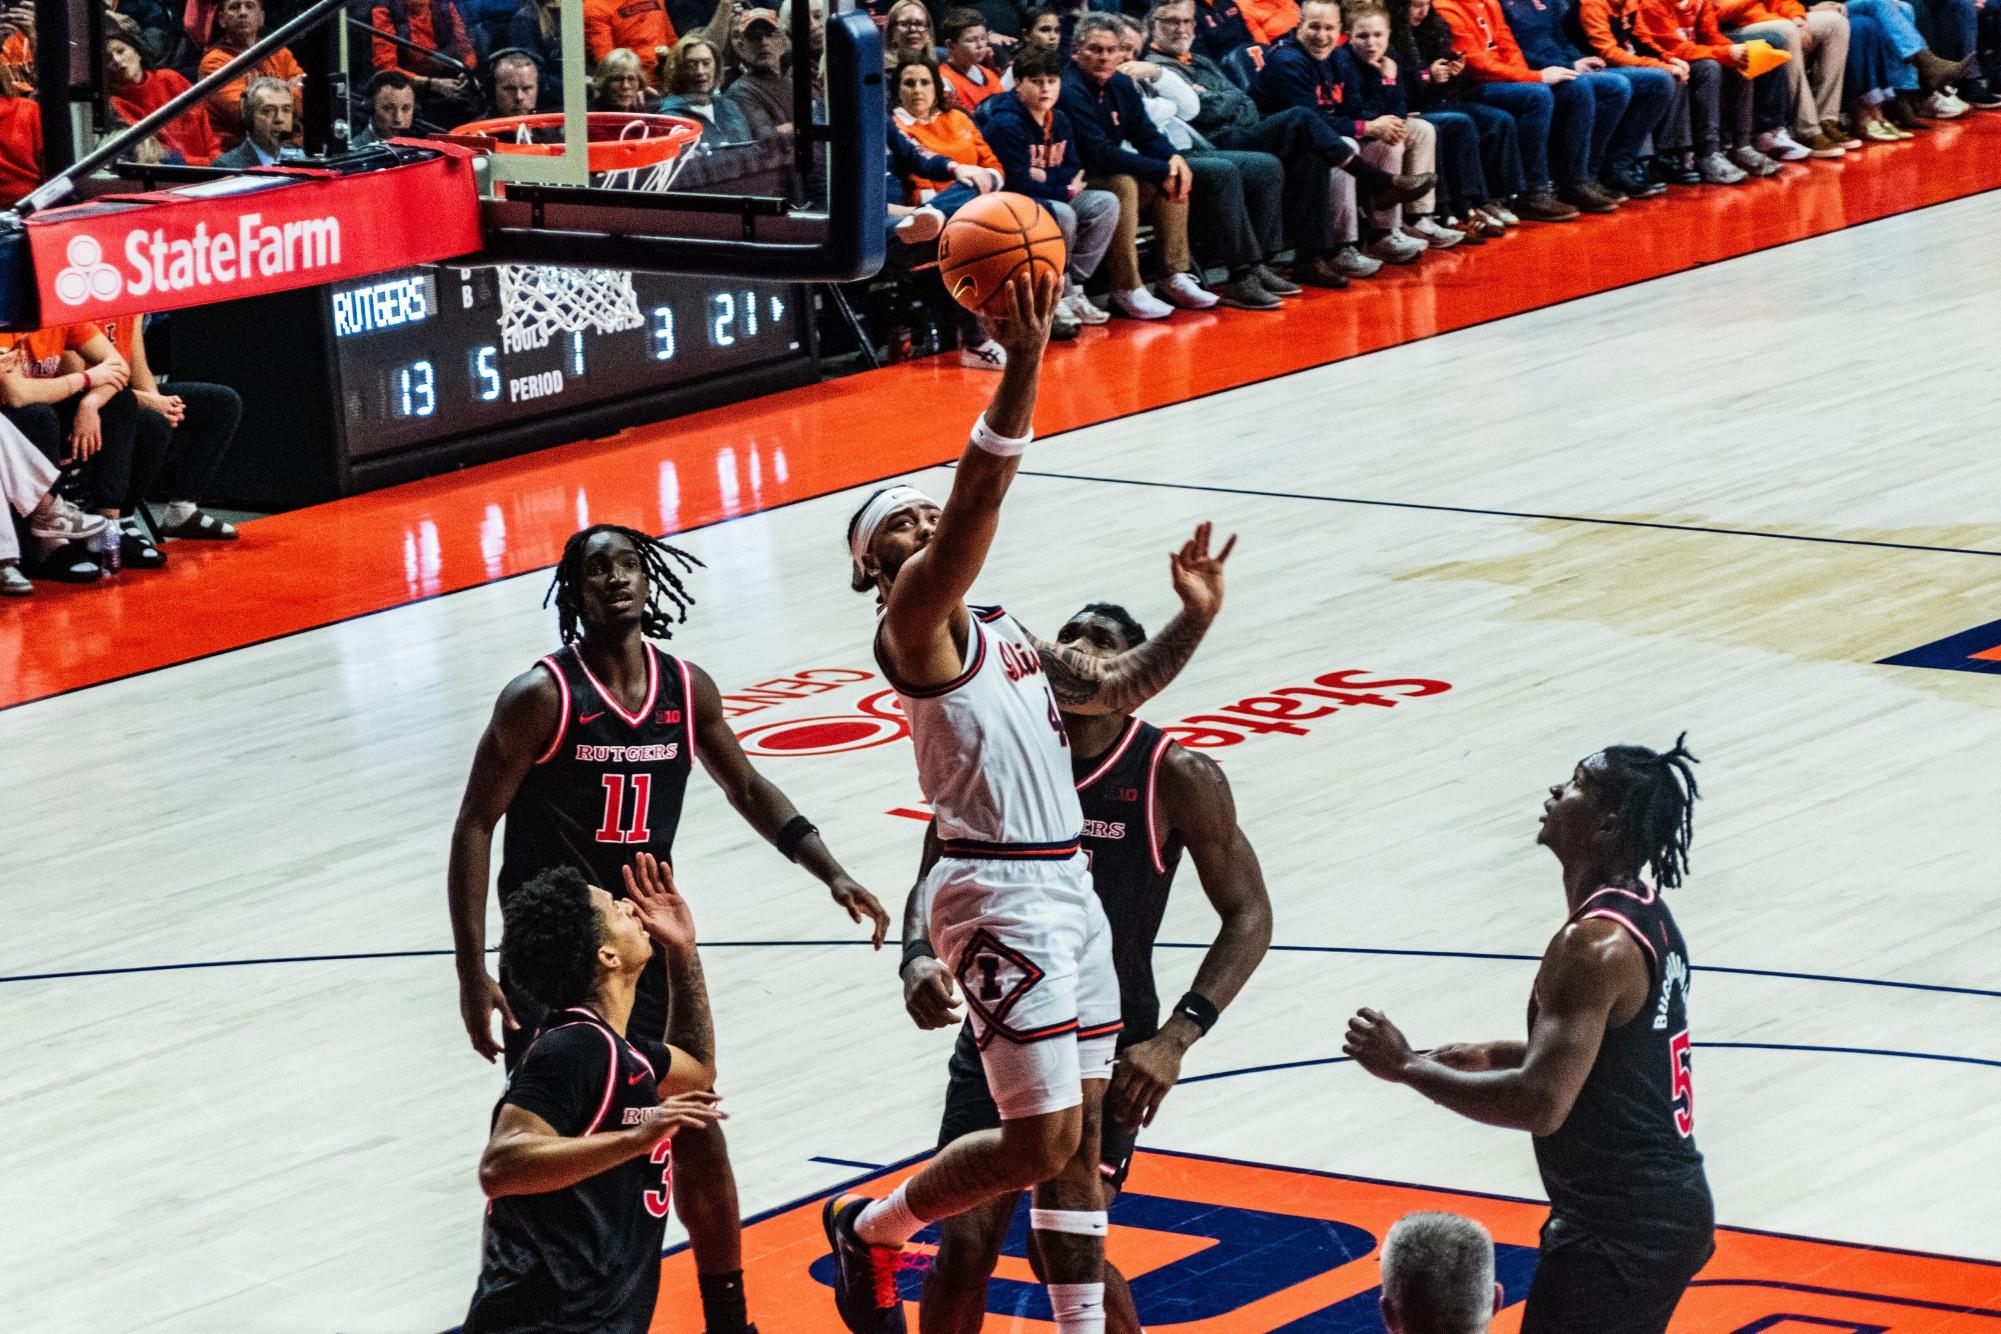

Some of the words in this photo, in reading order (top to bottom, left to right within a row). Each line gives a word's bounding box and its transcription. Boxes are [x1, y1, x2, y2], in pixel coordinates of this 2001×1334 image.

[332, 276, 427, 337] RUTGERS
[462, 285, 473, 309] B
[715, 291, 758, 346] 21
[503, 328, 549, 354] FOULS
[574, 330, 584, 375] 1
[655, 307, 674, 360] 3
[401, 361, 435, 416] 13
[477, 346, 500, 401] 5
[509, 369, 564, 402] PERIOD
[1160, 669, 1453, 748] State
[576, 743, 679, 762] RUTGERS
[595, 773, 652, 843] 11
[644, 1137, 673, 1218] 3
